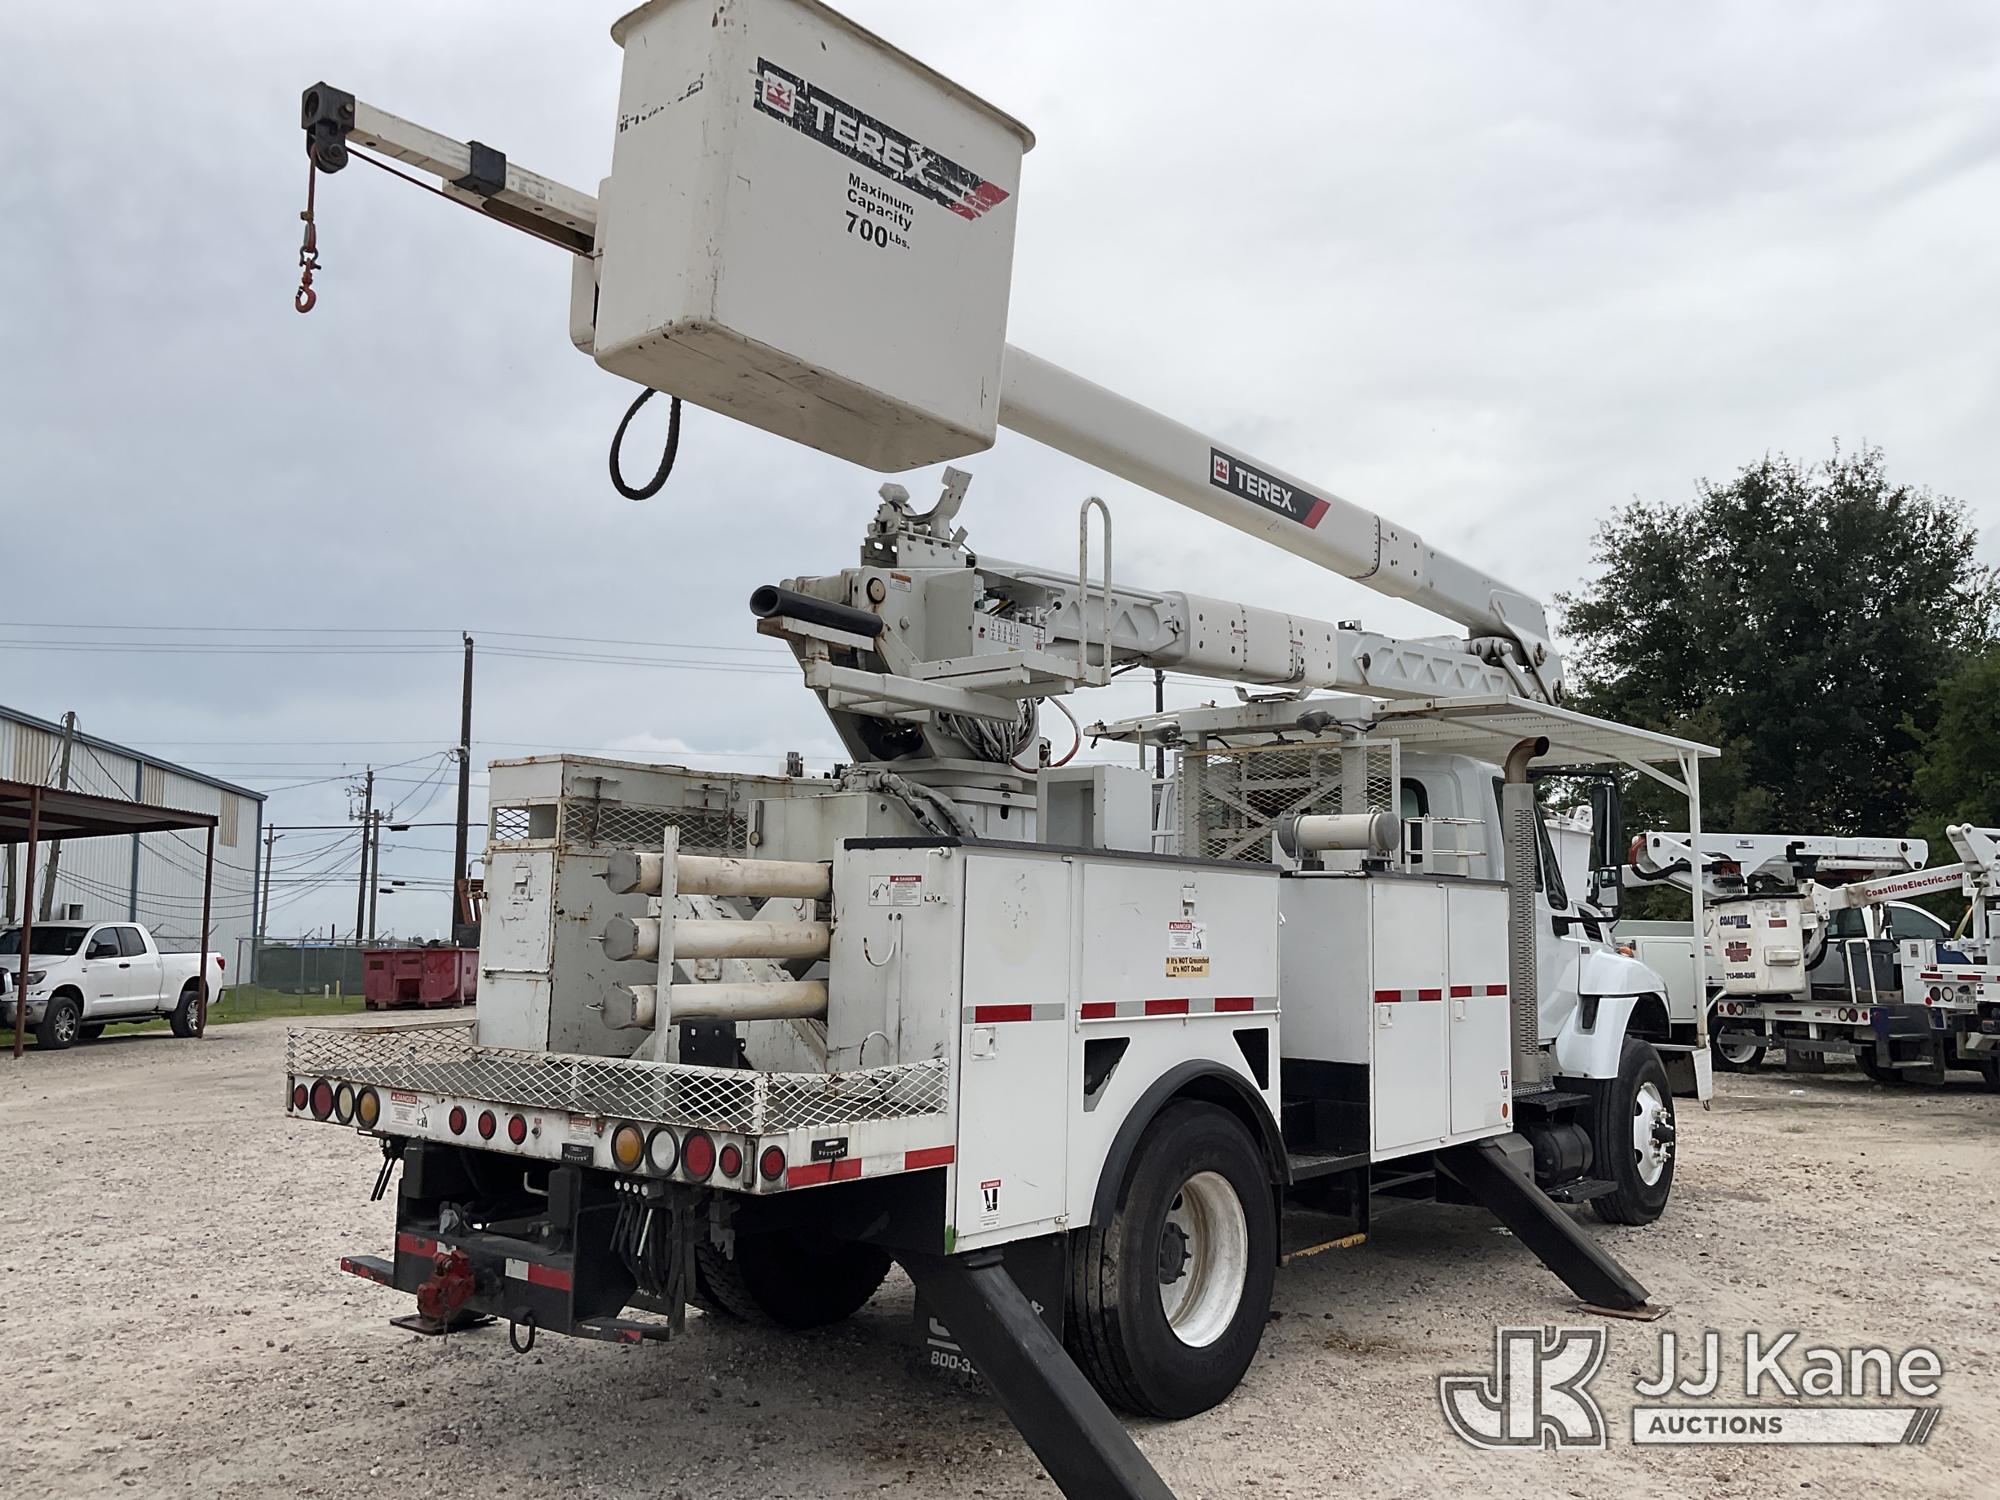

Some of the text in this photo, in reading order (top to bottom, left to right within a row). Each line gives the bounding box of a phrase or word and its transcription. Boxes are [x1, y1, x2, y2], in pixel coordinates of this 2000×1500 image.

[809, 97, 930, 184] TEREX
[847, 189, 912, 232] Capacity
[848, 173, 914, 215] Maximum
[845, 210, 888, 248] 700
[1235, 466, 1293, 512] TEREX
